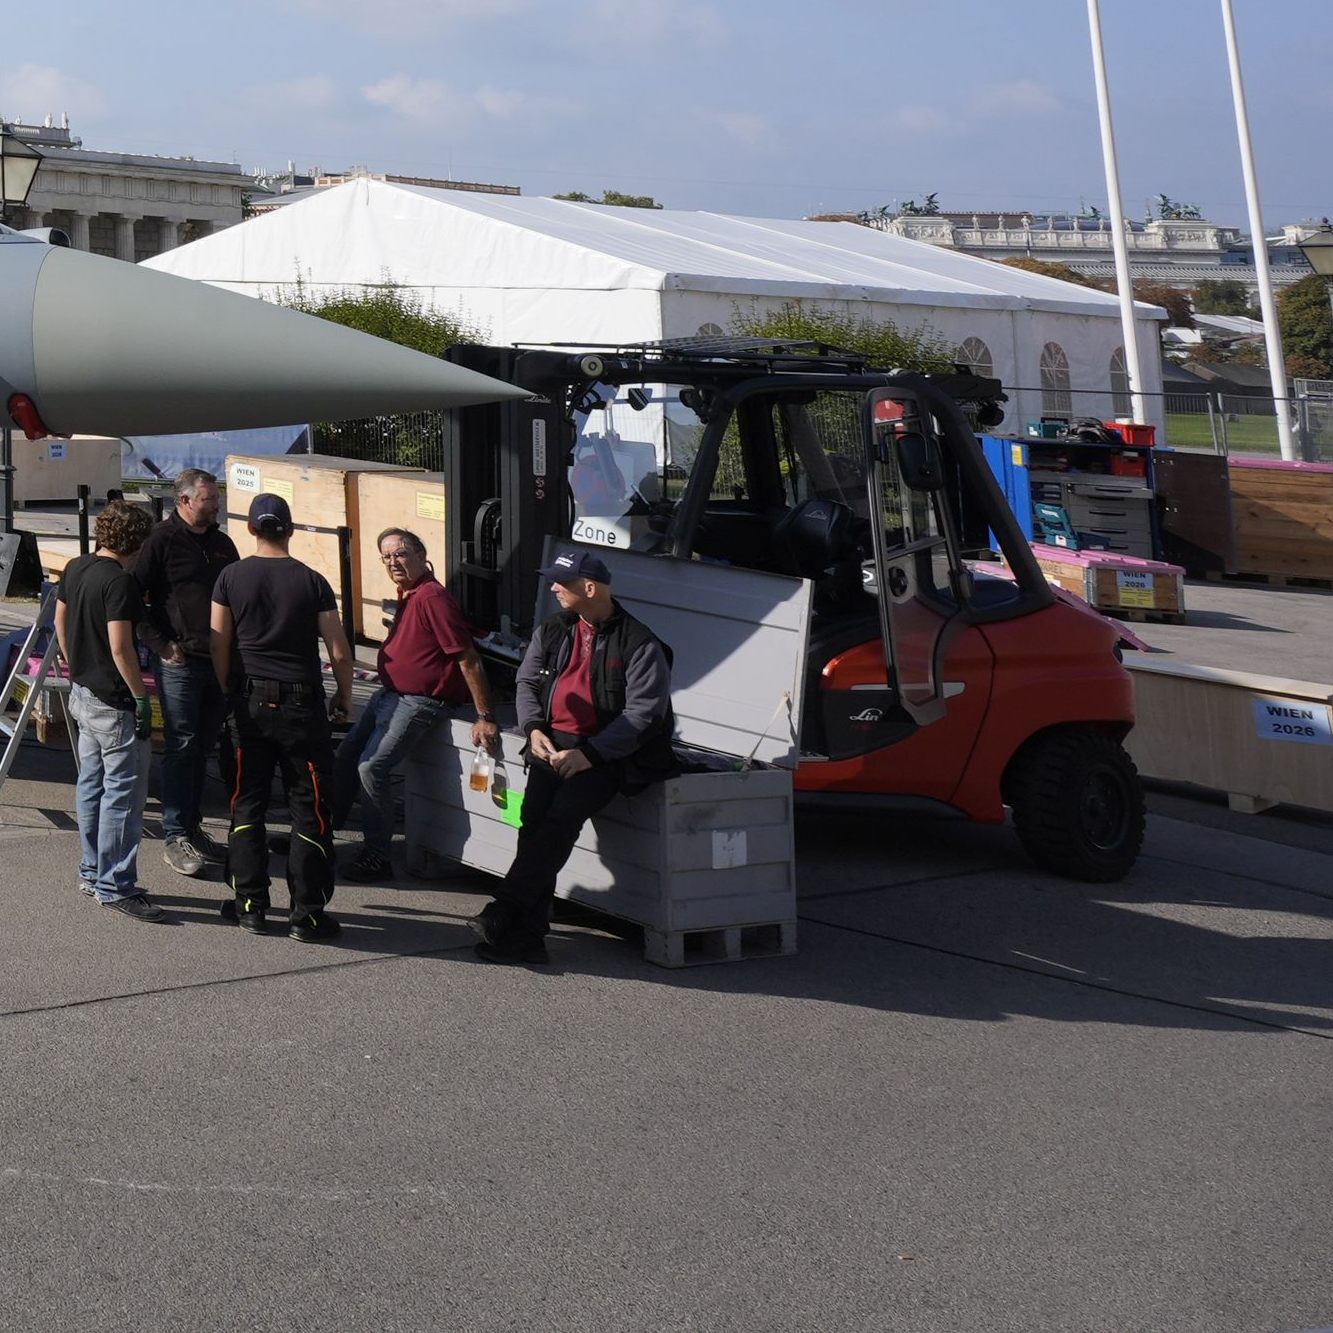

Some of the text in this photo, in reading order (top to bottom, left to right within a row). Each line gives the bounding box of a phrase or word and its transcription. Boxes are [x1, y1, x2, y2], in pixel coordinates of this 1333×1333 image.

[236, 467, 255, 476] WIEN
[574, 520, 617, 544] Zone
[1124, 580, 1146, 588] 2026
[1266, 706, 1314, 720] WIEN
[1272, 723, 1316, 737] 2026
